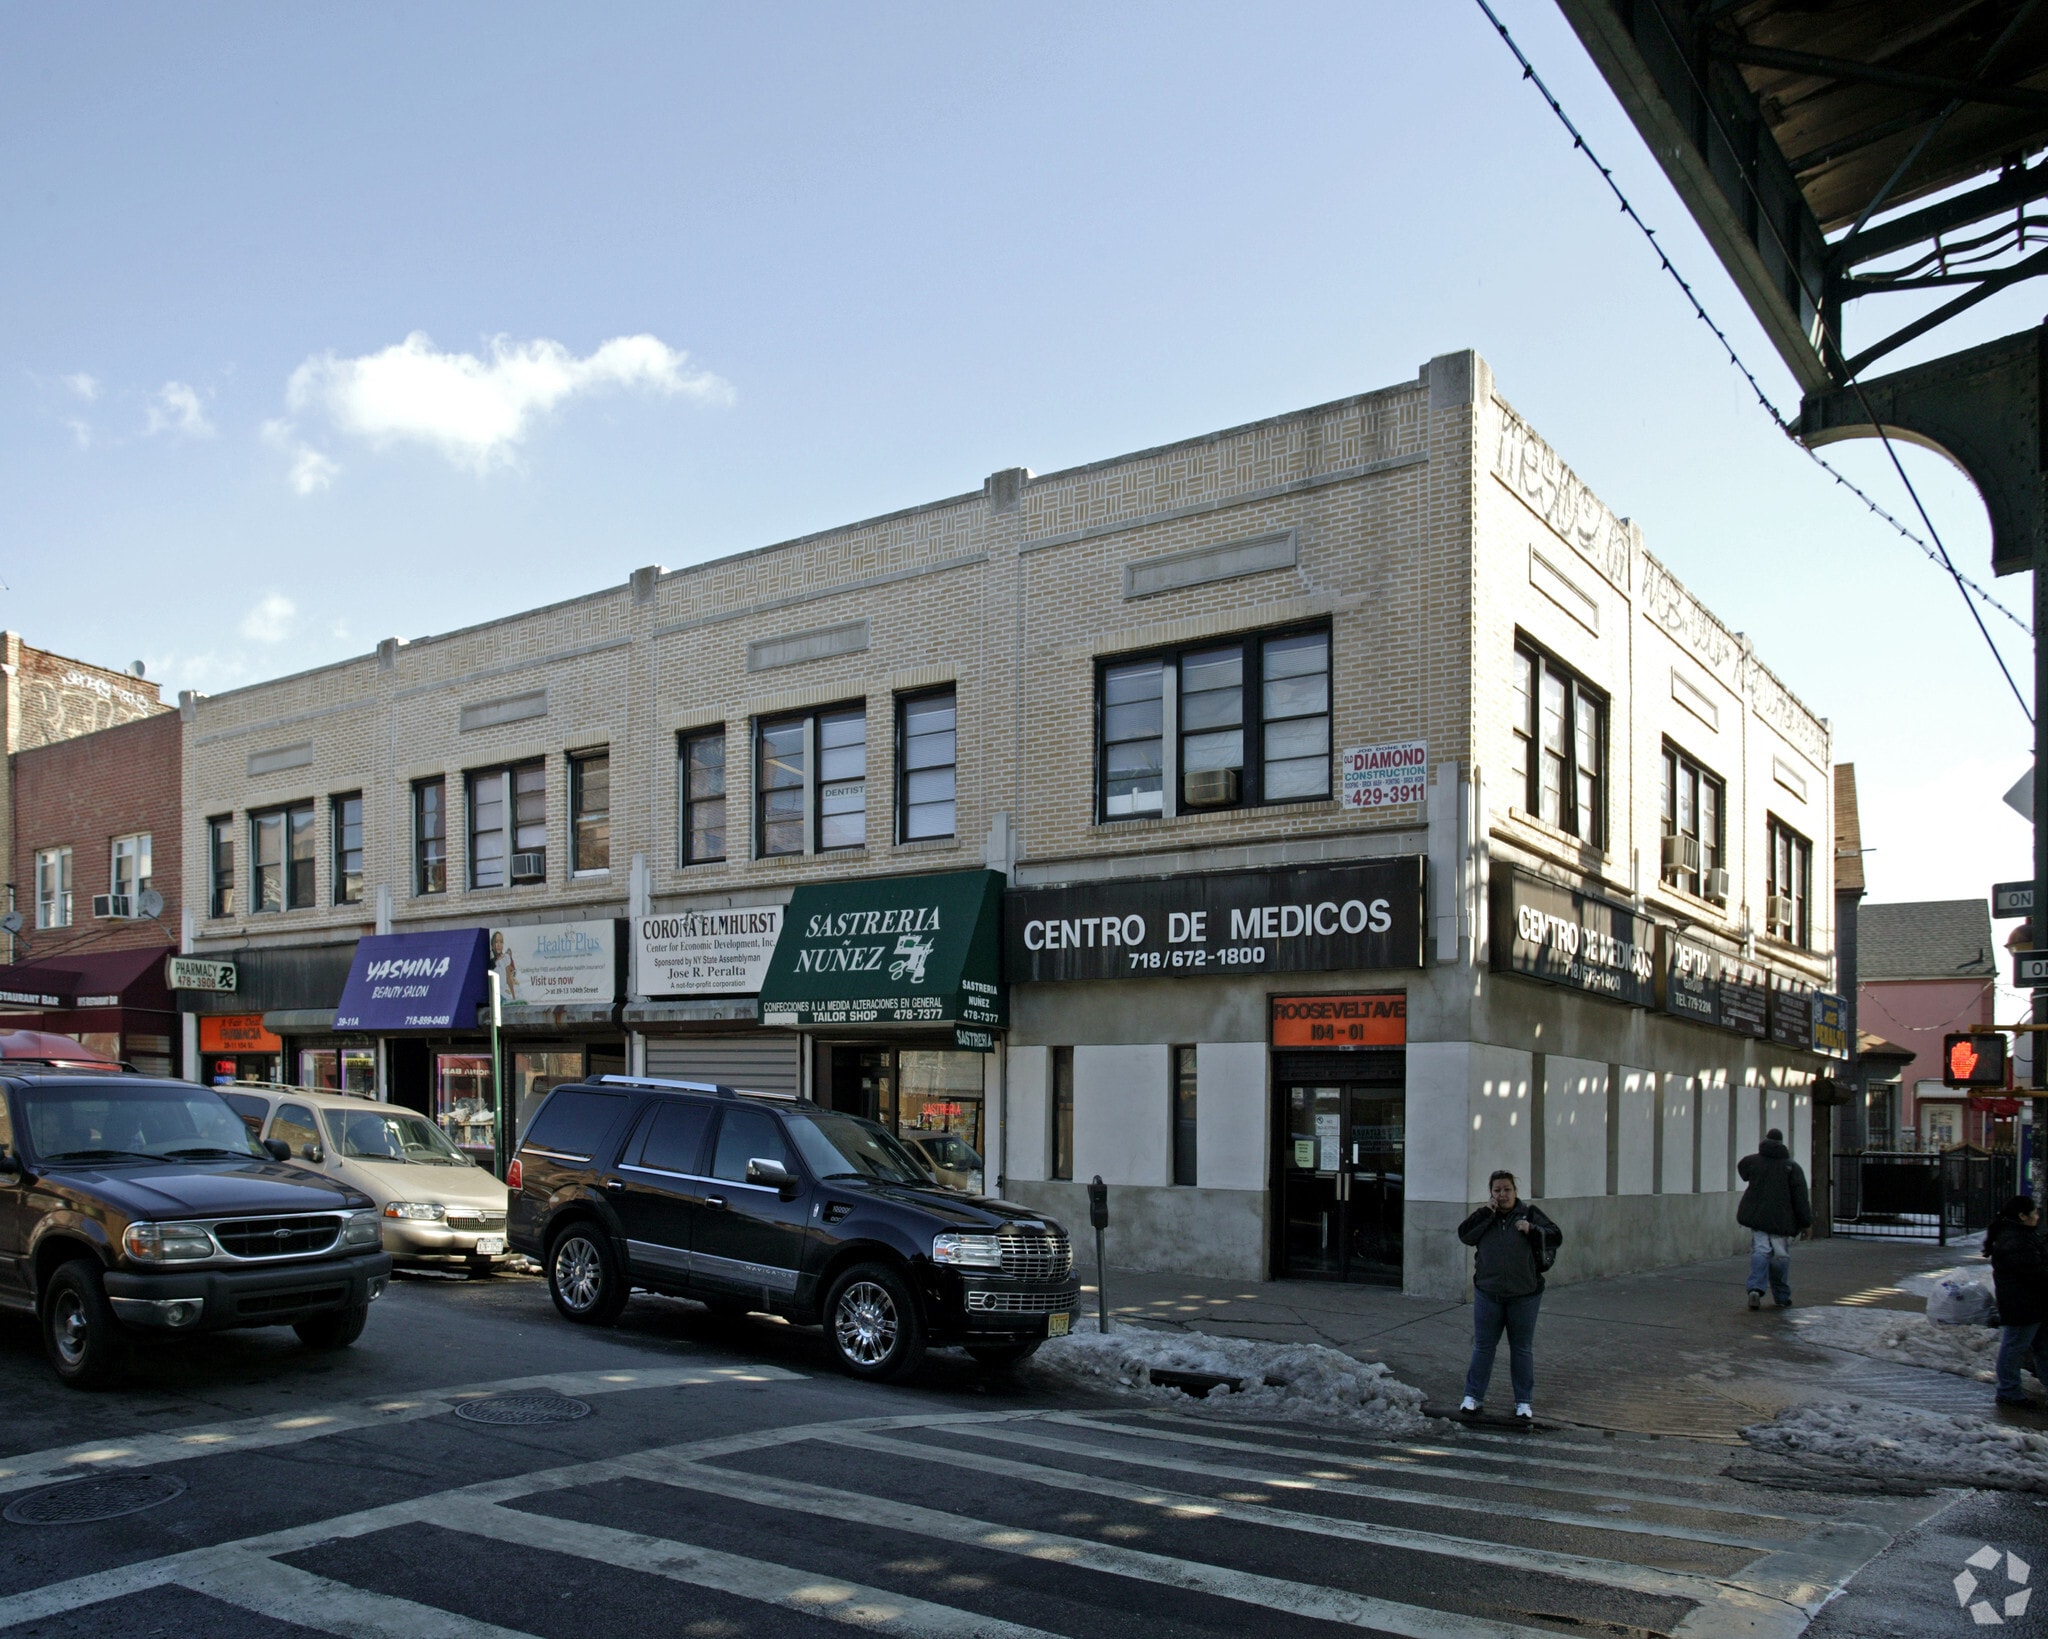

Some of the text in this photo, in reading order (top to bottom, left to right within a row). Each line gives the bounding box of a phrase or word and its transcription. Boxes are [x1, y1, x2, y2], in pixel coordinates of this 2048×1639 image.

[1354, 748, 1425, 771] DIAMOND
[1345, 766, 1425, 781] CONSTRUCTION
[825, 785, 865, 797] DENTIST
[1352, 784, 1425, 806] 429-3911
[2009, 893, 2031, 906] ON
[643, 912, 776, 940] CORONA ELMHURST
[805, 905, 941, 938] SASTRERIA
[1023, 898, 1393, 951] CENTRO DE MEDICOS
[537, 932, 600, 953] Health Plus
[646, 943, 667, 953] Center
[669, 942, 678, 952] for
[680, 941, 712, 951] Economic
[762, 937, 776, 947] Inc.
[1518, 904, 1653, 978] CENTRO DE MEDICOS
[654, 953, 760, 967] Sponsored by NY State Assemblyman
[793, 939, 886, 973] NUÑEZ
[1129, 946, 1266, 970] 718/672-1800
[176, 962, 217, 977] PHARMACY
[366, 957, 450, 982] YASMINA
[667, 966, 746, 980] Jose R. Peralta
[531, 976, 546, 986] Visit
[558, 976, 574, 985] now
[670, 980, 745, 990] A not-for-profit corporation
[962, 979, 998, 995] SASTRERIA
[372, 985, 429, 999] BEAUTY SALON
[41, 995, 59, 1006] BAR
[763, 997, 943, 1013] CONFECCIONES A LA MEDIDA ALTERACIONES EN GENERAL
[968, 995, 990, 1008] NUÑEZ
[813, 1009, 943, 1022] TAILOR SHOP 478-7377
[963, 1009, 999, 1023] 478-7377
[1274, 1001, 1406, 1020] ROOSEVELT AVE
[337, 1017, 359, 1026] 39-11A
[956, 1029, 993, 1047] SASTRERIA
[922, 1103, 962, 1116] SASTRERIA
